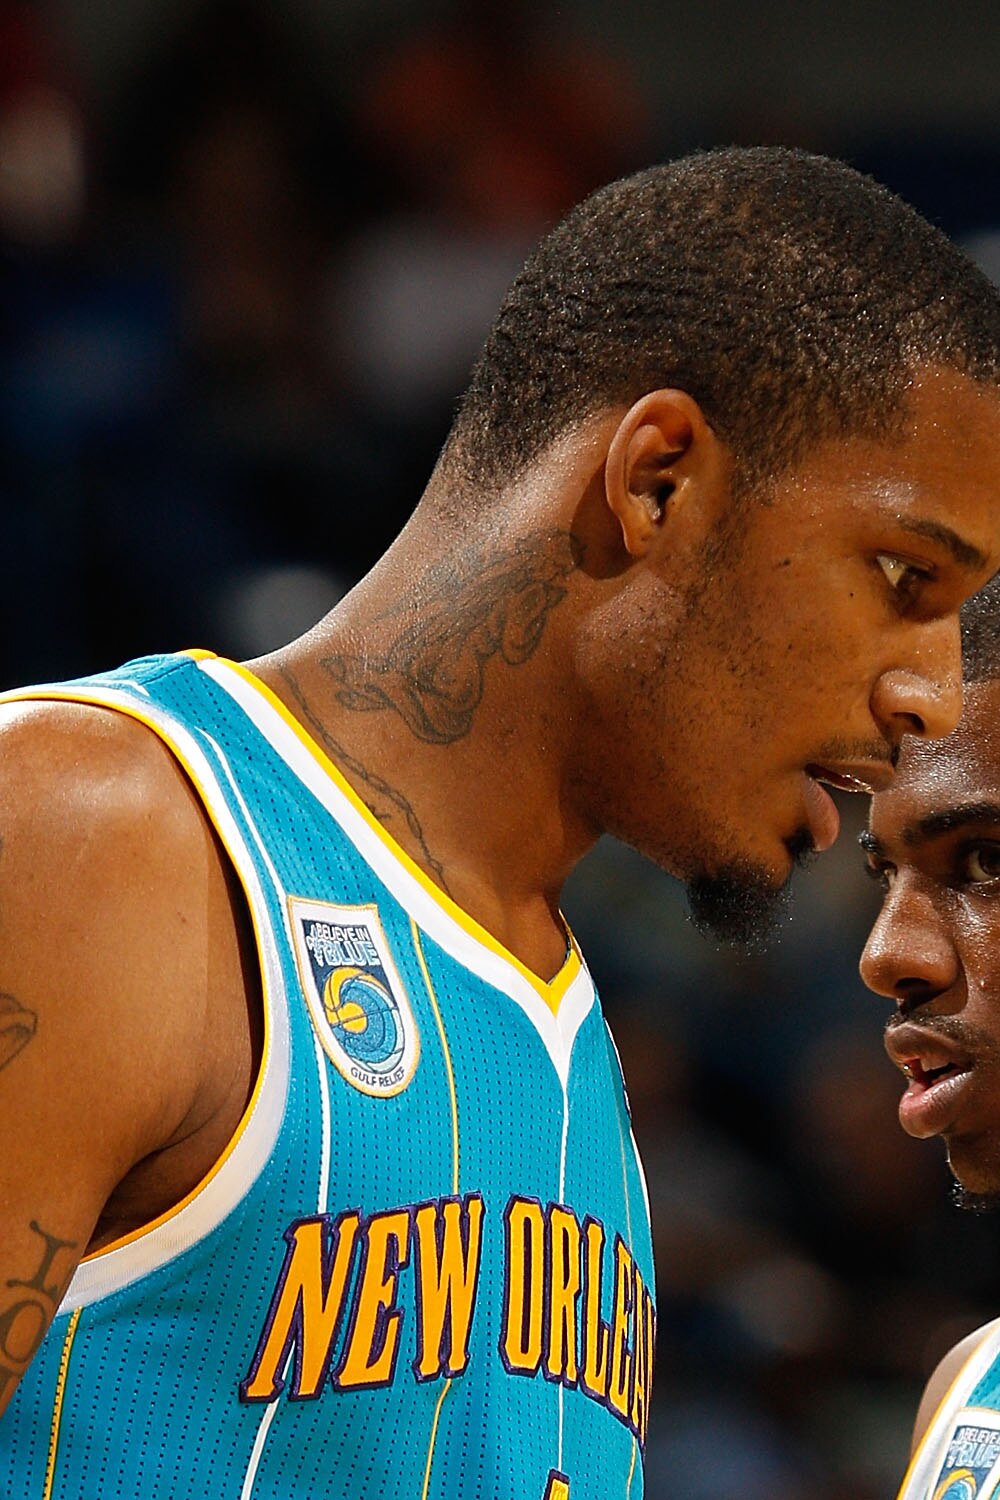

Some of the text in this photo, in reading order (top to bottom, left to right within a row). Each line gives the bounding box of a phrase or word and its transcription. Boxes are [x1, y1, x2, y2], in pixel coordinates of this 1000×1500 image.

[351, 1066, 405, 1087] GULF RELIEF
[239, 1190, 485, 1403] NEW
